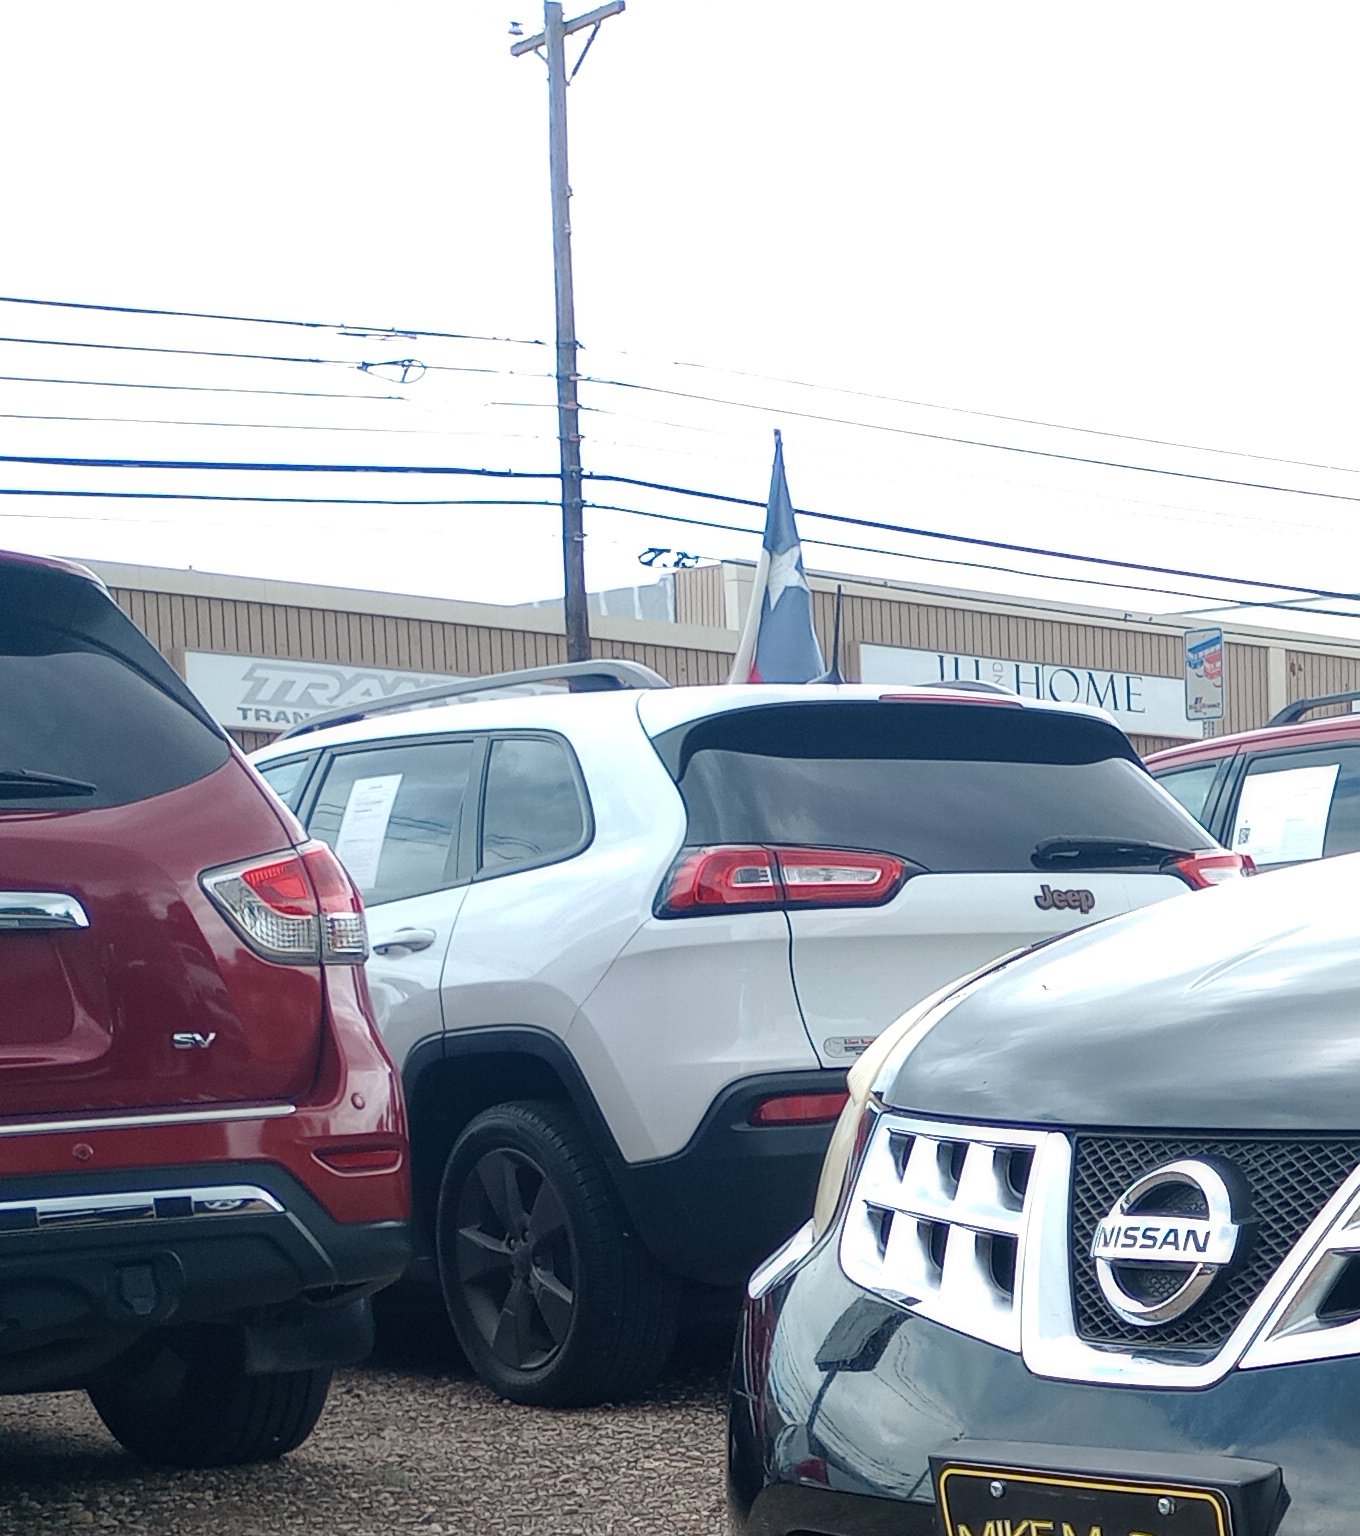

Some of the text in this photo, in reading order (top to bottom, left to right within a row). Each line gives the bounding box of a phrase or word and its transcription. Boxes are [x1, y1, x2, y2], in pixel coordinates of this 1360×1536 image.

[1014, 663, 1146, 714] HOME
[1034, 884, 1095, 914] Jeep
[173, 1032, 216, 1049] SV
[1097, 1225, 1211, 1253] NISSAN
